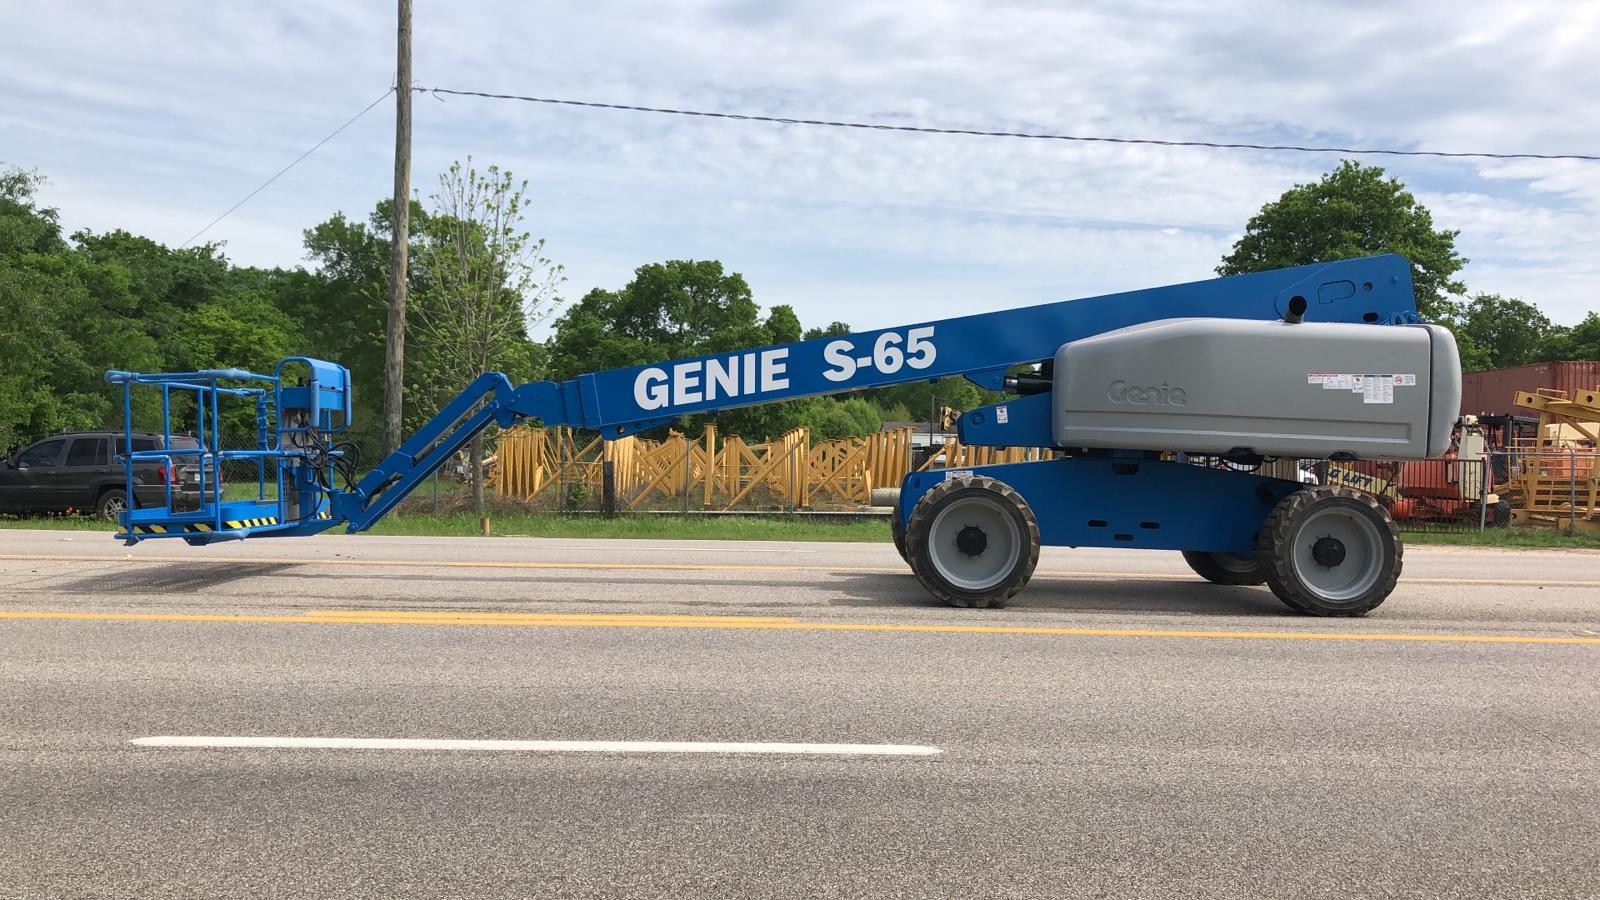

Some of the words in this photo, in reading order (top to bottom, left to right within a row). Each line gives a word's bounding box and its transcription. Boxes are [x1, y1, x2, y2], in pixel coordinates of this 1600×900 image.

[634, 347, 789, 411] GENIE
[822, 326, 937, 382] S-65
[1105, 379, 1186, 406] Genie
